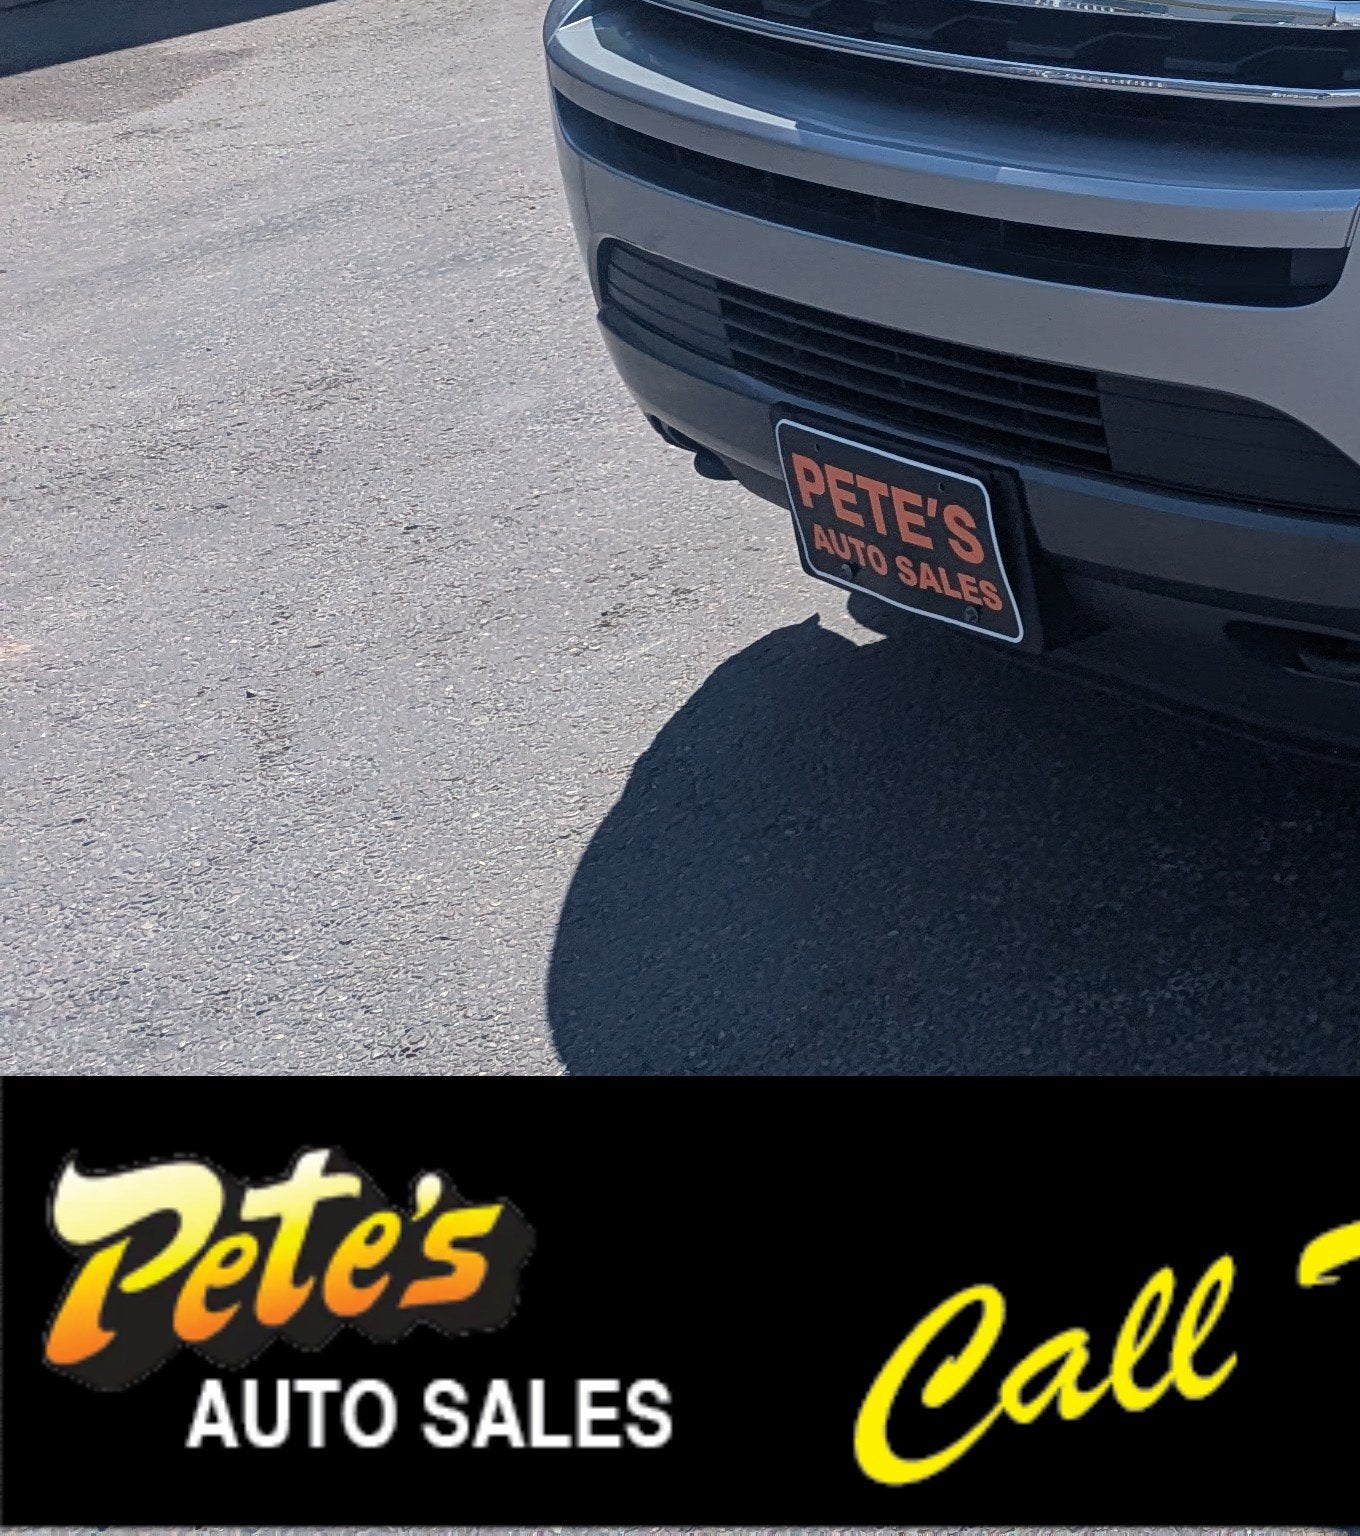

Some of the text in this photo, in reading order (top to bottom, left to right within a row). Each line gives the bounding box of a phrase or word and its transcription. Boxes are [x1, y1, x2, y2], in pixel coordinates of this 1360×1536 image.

[791, 452, 986, 565] PETE'S
[813, 523, 1004, 612] AUTO SALES
